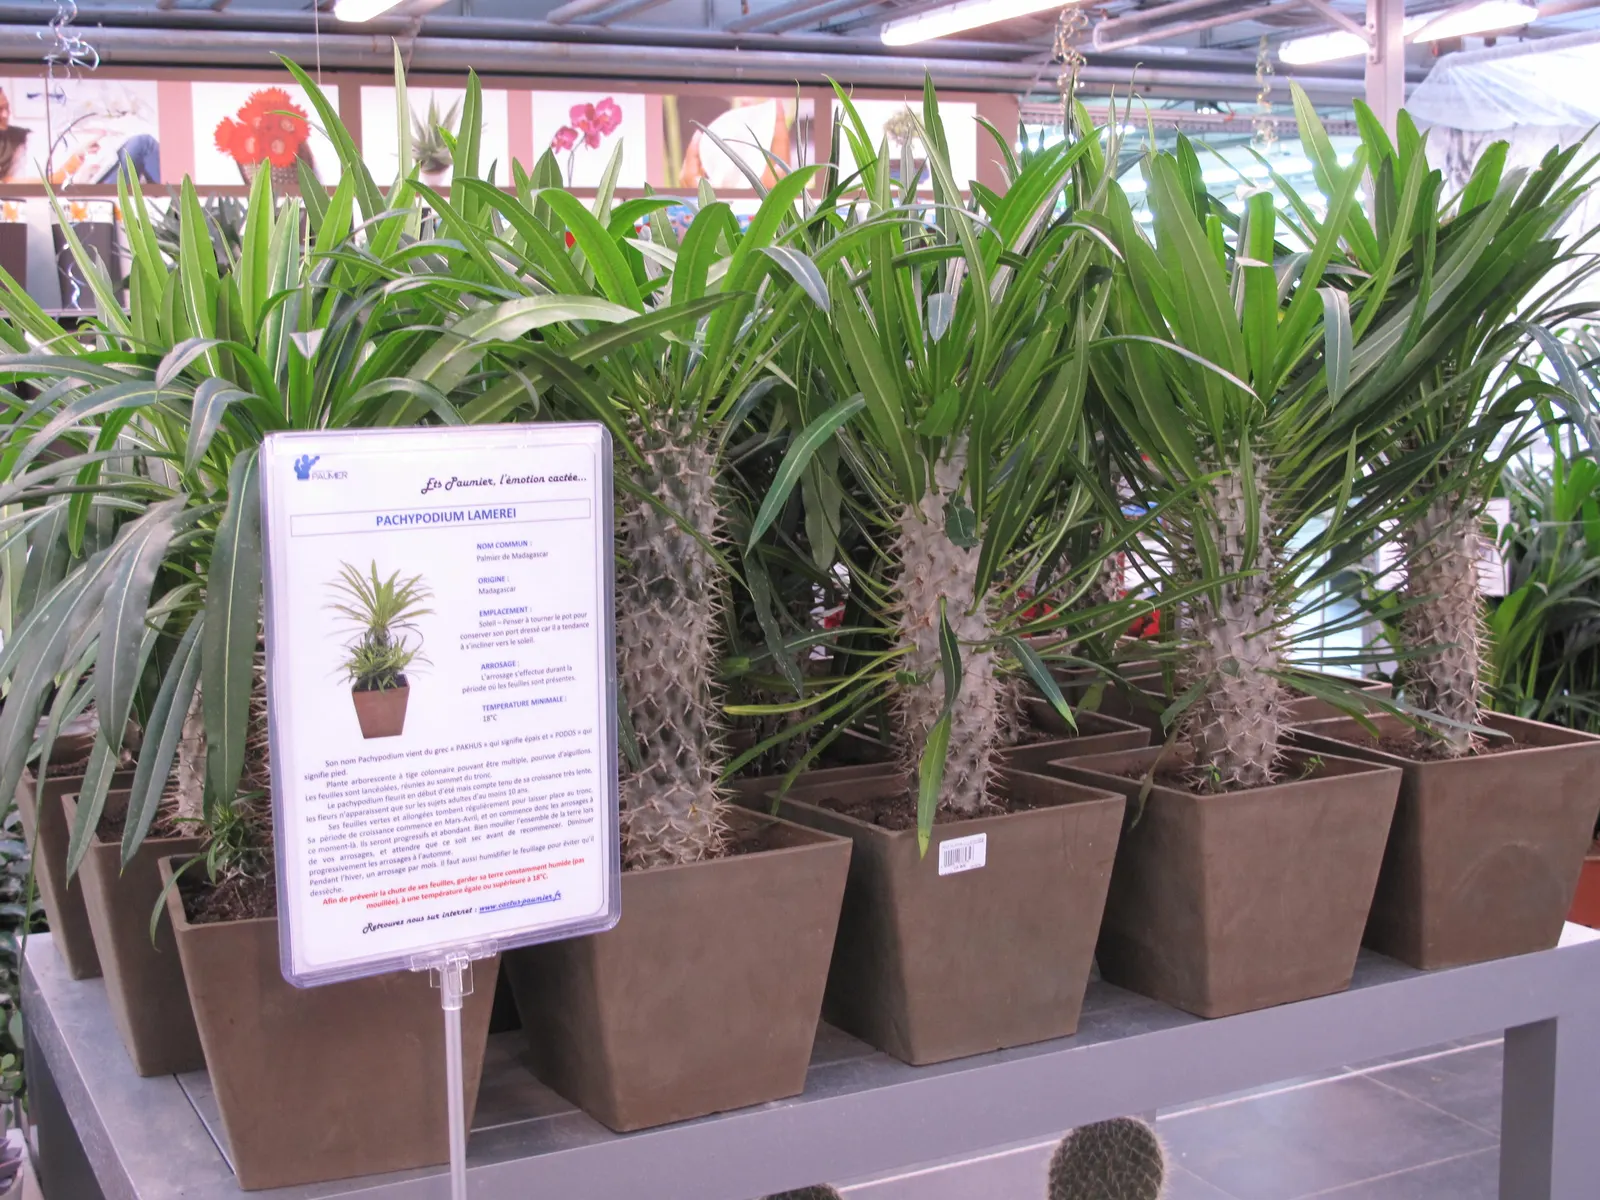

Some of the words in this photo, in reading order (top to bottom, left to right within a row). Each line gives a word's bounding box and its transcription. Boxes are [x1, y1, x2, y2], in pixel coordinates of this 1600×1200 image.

[421, 477, 442, 494] Ets
[445, 476, 496, 491] Paumier,
[500, 473, 545, 485] l'émotion
[376, 511, 464, 526] PACHYPODIUM
[468, 508, 516, 520] LAMEREI
[512, 552, 548, 560] Madagascar
[478, 576, 505, 584] ORIGINE
[478, 587, 516, 595] Madagascar
[479, 606, 527, 617] EMPLACEMENT
[479, 620, 496, 628] Soleil
[562, 613, 572, 621] pot
[520, 626, 540, 634] dressé
[562, 622, 589, 630] tendance
[466, 642, 494, 650] s'incliner
[481, 660, 516, 670] ARROSAGE
[481, 673, 513, 681] L'arrosage
[514, 669, 544, 677] s'effectue
[546, 666, 566, 674] durant
[462, 685, 486, 694] période
[508, 680, 530, 688] feuilles
[482, 700, 529, 711] TEMPERATURE
[531, 696, 563, 705] MINIMALE
[358, 753, 404, 763] Pachypodium
[456, 742, 482, 751] PAKHUS
[489, 740, 499, 748] qui
[501, 737, 523, 746] signifie
[524, 735, 540, 743] épais
[555, 730, 576, 738] PODOS
[304, 771, 329, 781] signifie
[351, 774, 396, 785] arborescente
[420, 767, 454, 776] colonnaire
[457, 763, 483, 772] pouvant
[501, 757, 528, 765] multiple,
[531, 754, 556, 763] pourvue
[309, 877, 338, 886] Pendant
[377, 868, 406, 876] arrosage
[408, 865, 418, 873] par
[479, 850, 511, 860] humidifier
[520, 845, 545, 853] feuillage
[547, 842, 561, 850] pour
[581, 836, 594, 844] qu'il
[350, 891, 378, 903] prévenir
[429, 880, 455, 888] feuilles,
[457, 876, 478, 885] garder
[505, 864, 547, 876] constamment
[548, 860, 571, 868] humide
[421, 889, 463, 899] température
[464, 885, 481, 893] égale
[493, 878, 526, 888] supérieure
[406, 916, 424, 924] nous
[442, 908, 472, 918] internet
